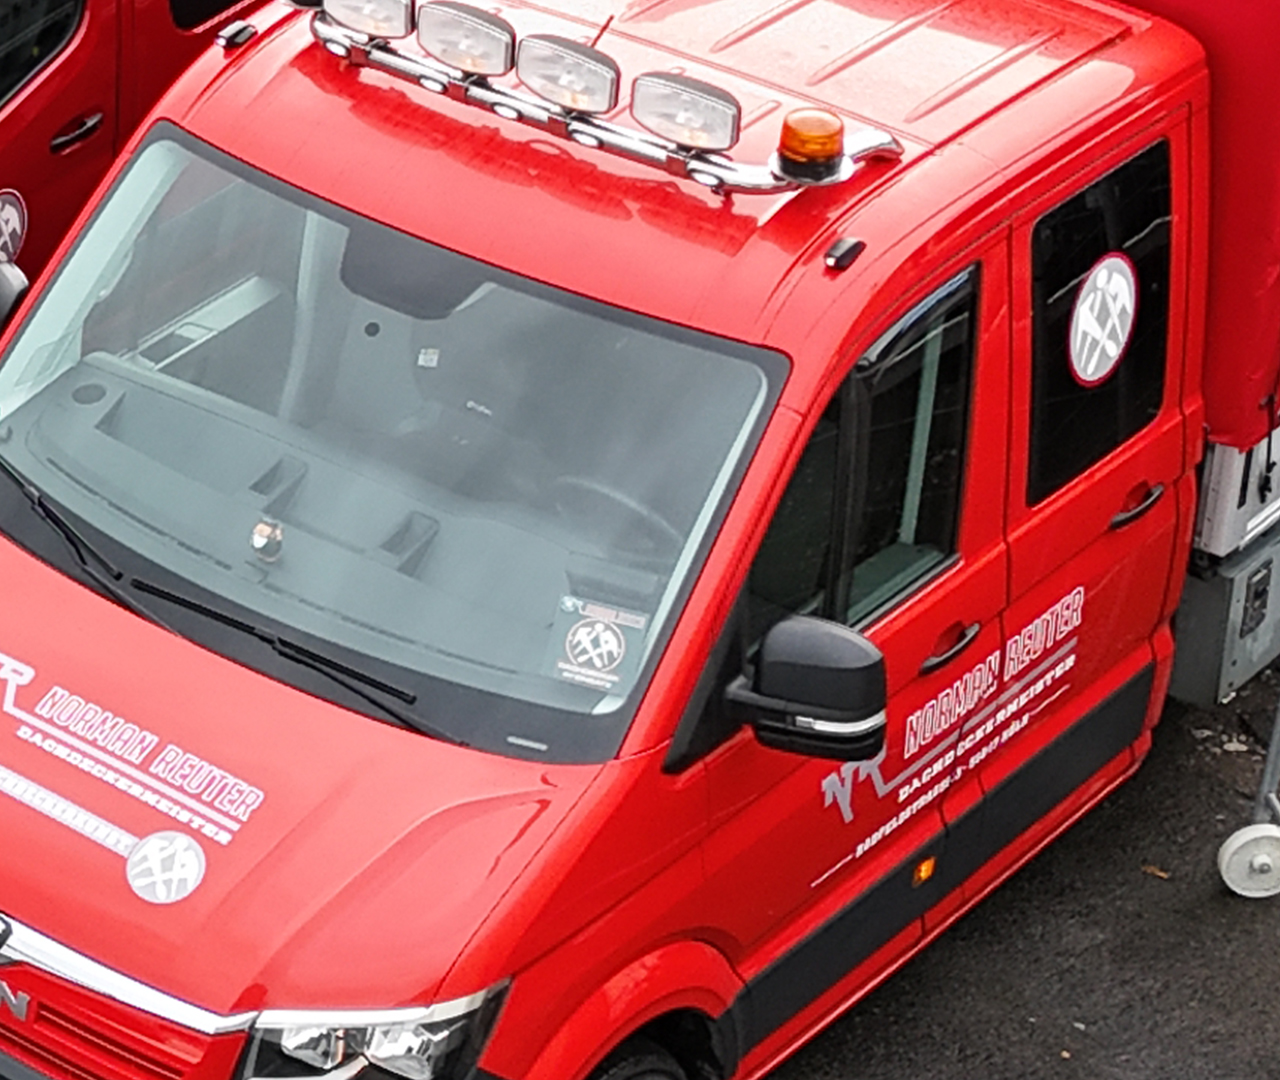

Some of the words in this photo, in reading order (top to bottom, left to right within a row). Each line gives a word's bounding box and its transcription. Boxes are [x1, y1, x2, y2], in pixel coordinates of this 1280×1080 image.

[903, 648, 1001, 760] NORMAN
[1003, 584, 1086, 682] REUTER
[34, 685, 160, 766] NORMAN
[147, 743, 265, 823] REUTER
